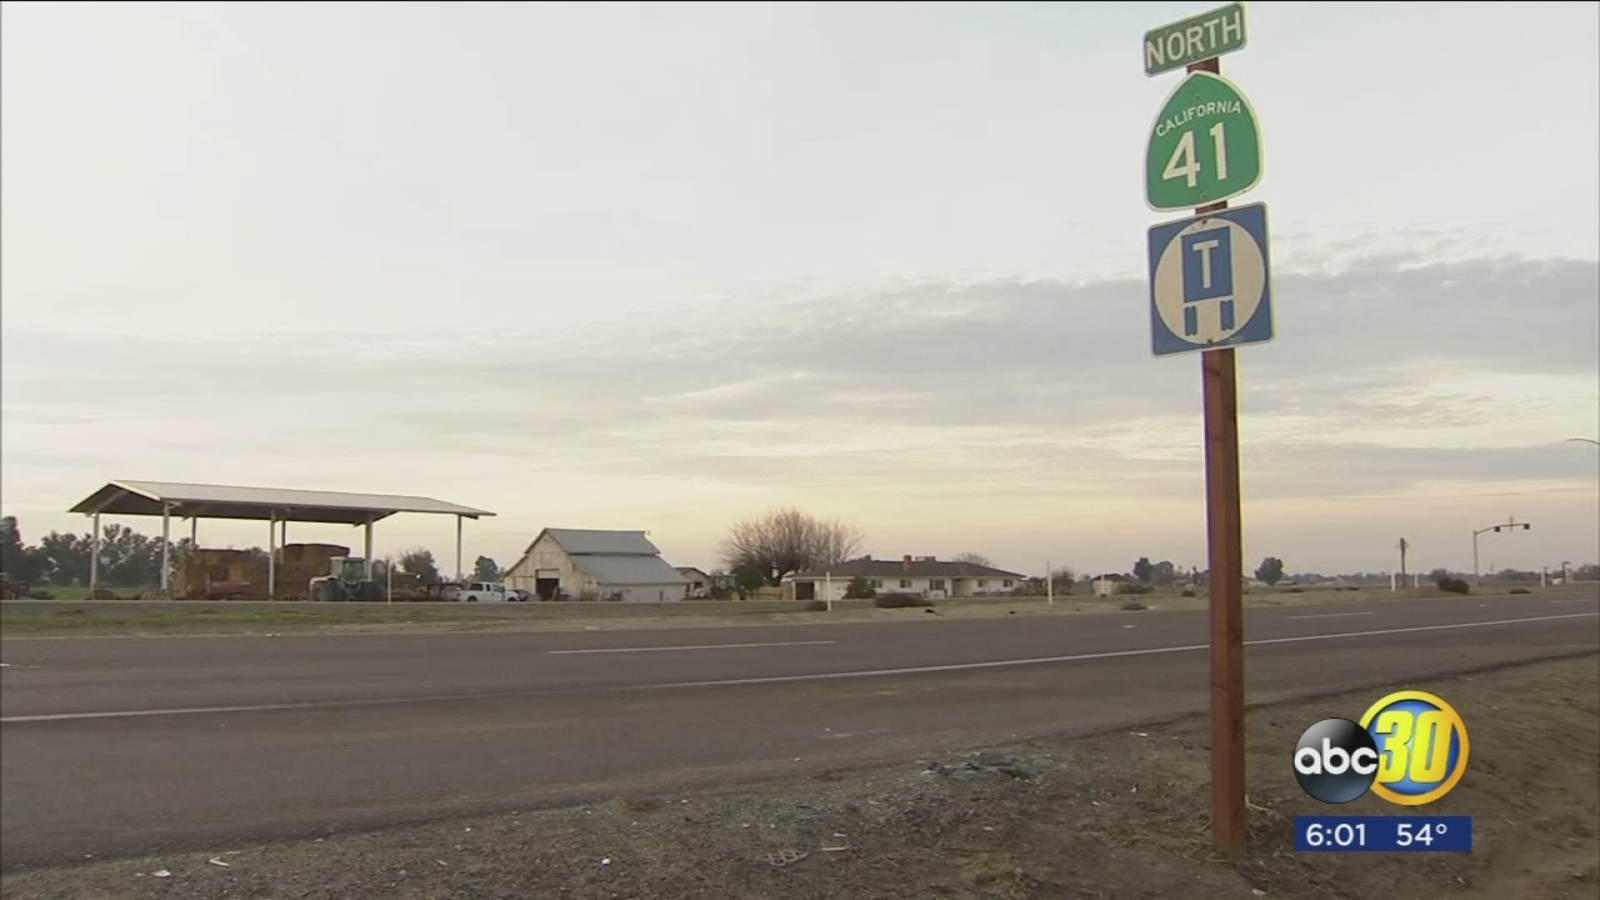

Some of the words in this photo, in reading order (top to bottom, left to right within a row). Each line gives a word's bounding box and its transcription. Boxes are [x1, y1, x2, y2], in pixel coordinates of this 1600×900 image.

[1145, 11, 1241, 69] NORTH
[1155, 101, 1241, 137] CALIFORNIA
[1162, 122, 1227, 188] 41
[1192, 239, 1219, 288] T
